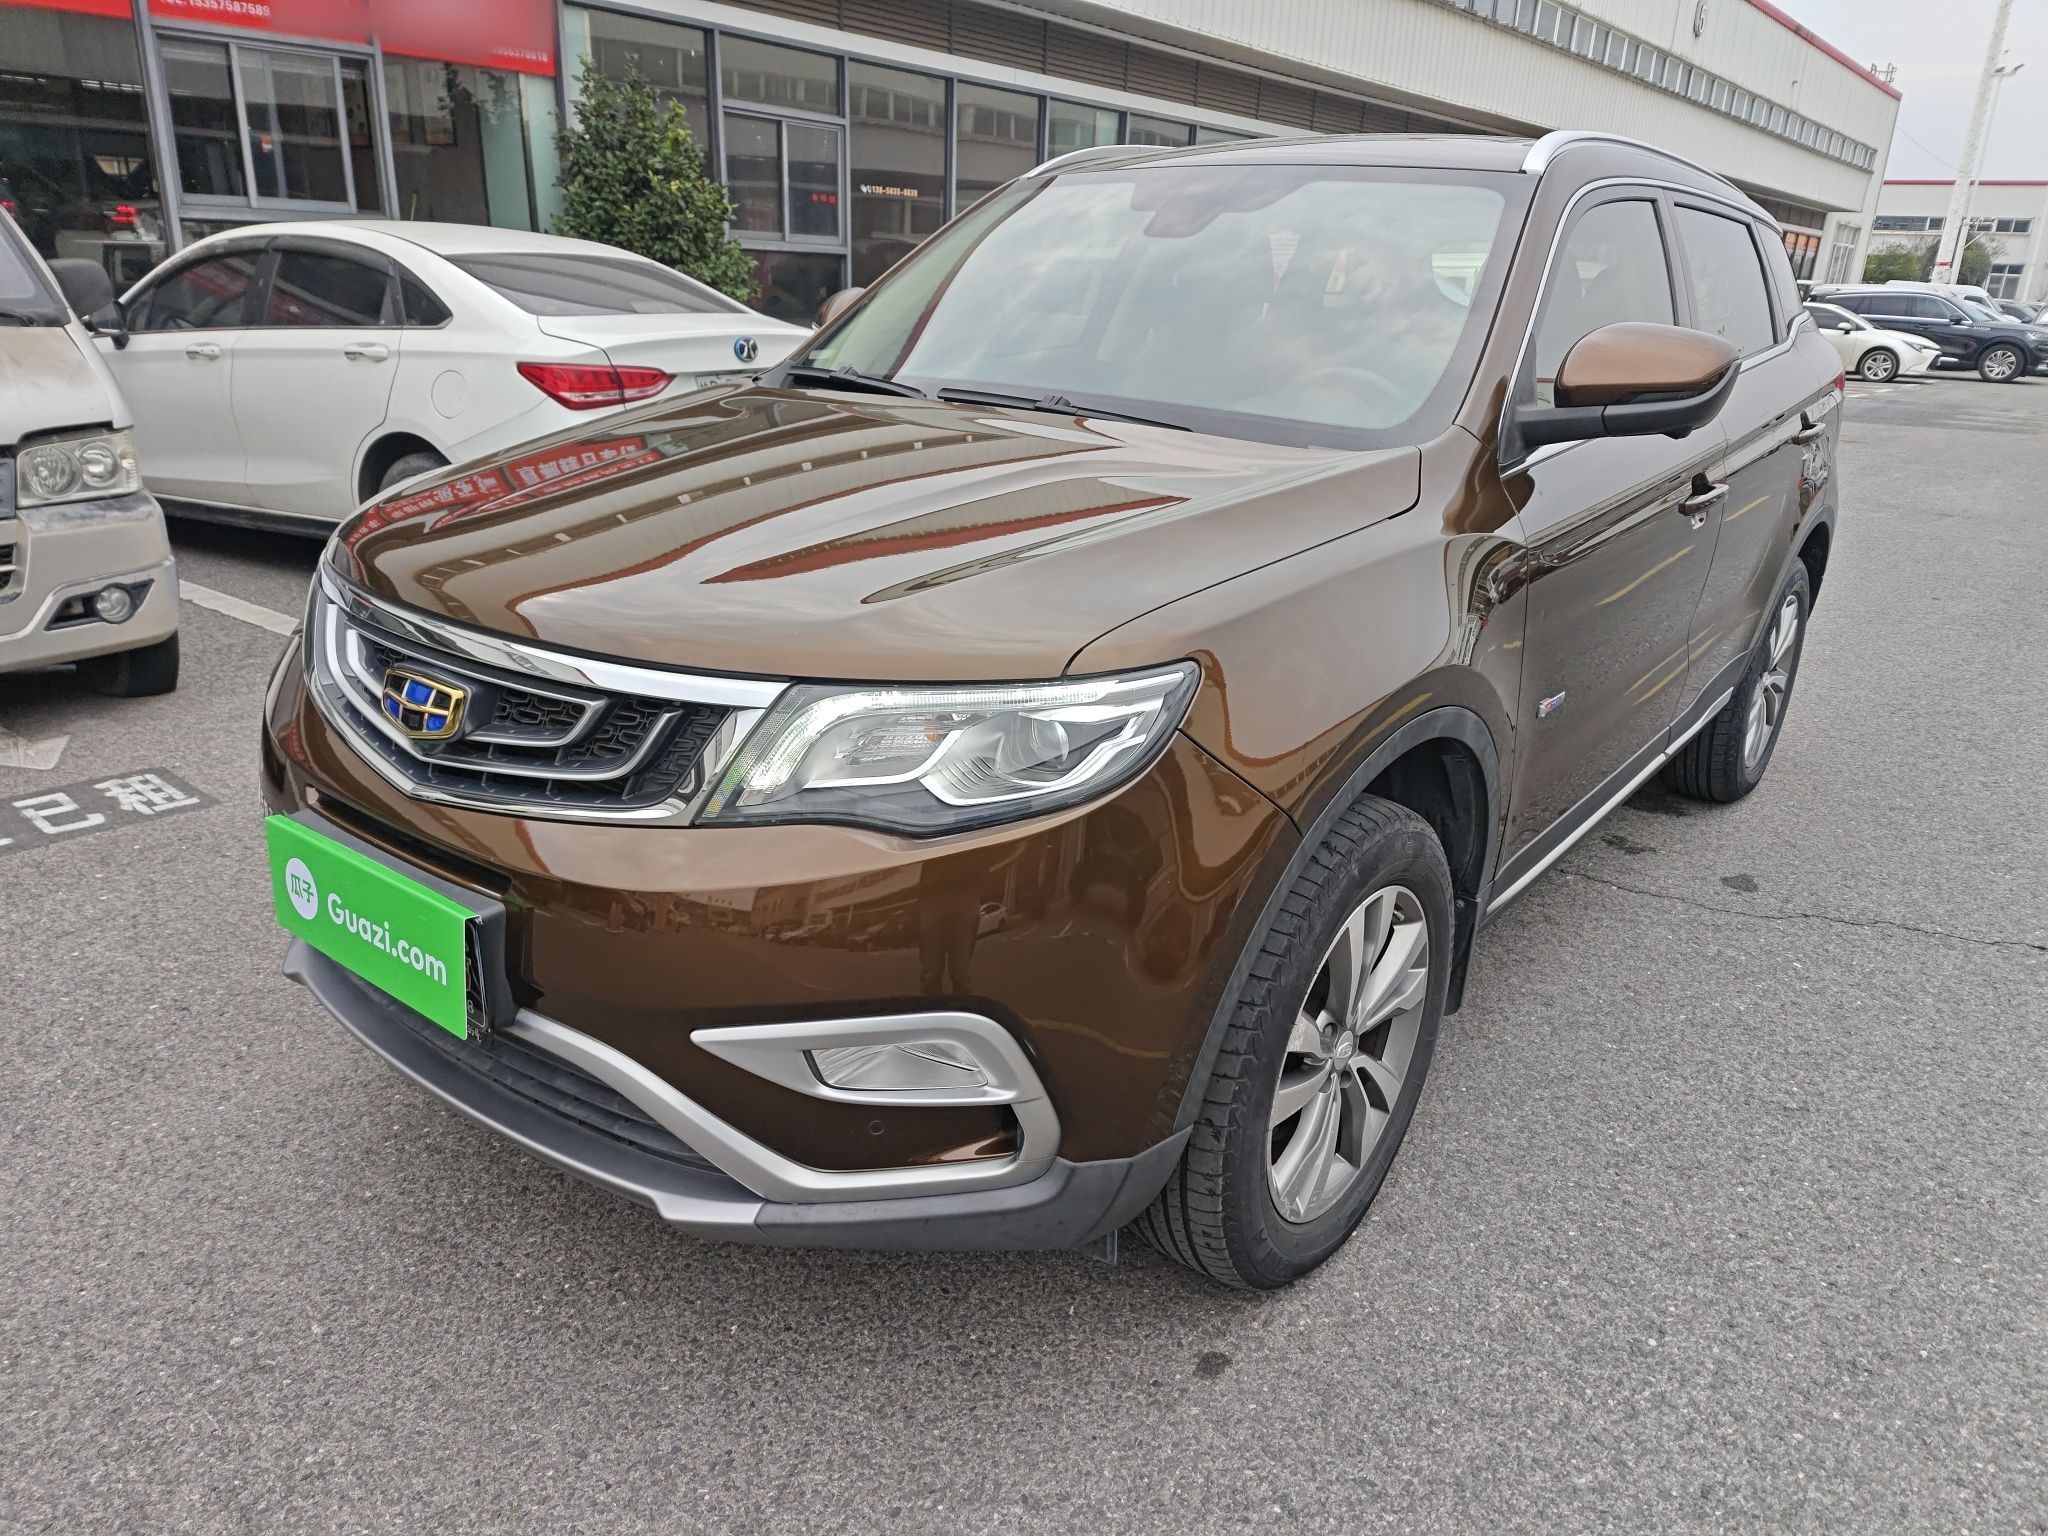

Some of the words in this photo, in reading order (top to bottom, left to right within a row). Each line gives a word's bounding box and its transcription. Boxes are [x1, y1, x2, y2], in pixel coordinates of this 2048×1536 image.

[0, 773, 201, 847] 已租
[291, 873, 314, 903] 瓜子
[328, 893, 447, 986] Guazi.com
